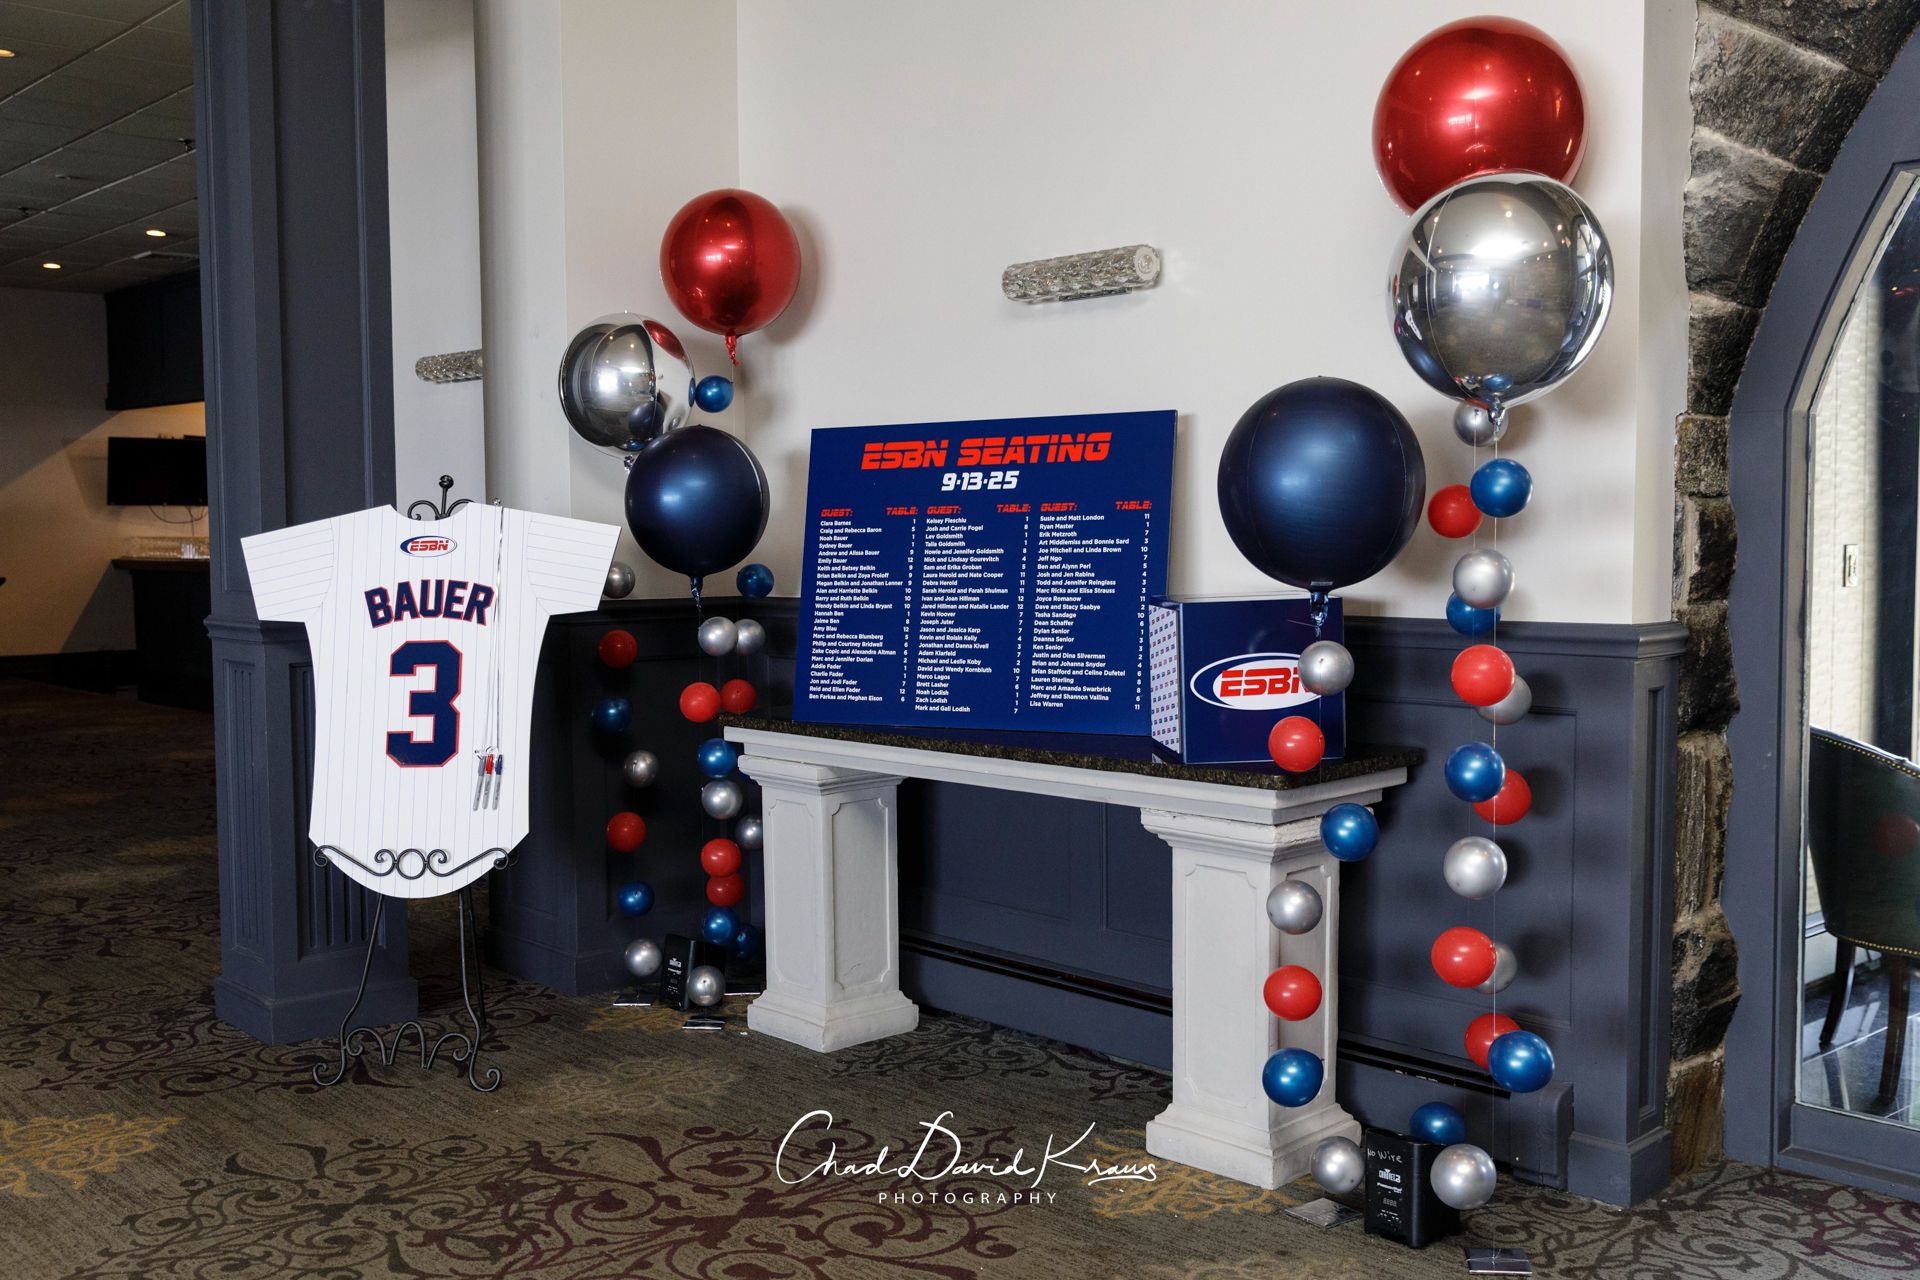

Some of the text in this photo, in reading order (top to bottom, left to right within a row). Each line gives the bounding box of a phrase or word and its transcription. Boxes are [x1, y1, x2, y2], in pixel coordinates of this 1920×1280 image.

[861, 432, 1112, 470] ESBN SEATING
[821, 507, 919, 517] GUEST: TABLE:
[926, 504, 1031, 515] GUEST: TABLE:
[1040, 500, 1153, 512] GUEST: TABLE:
[410, 539, 449, 551] ESBN
[364, 579, 495, 628] BAUER
[386, 640, 463, 768] 3
[1378, 1150, 1402, 1163] Wire
